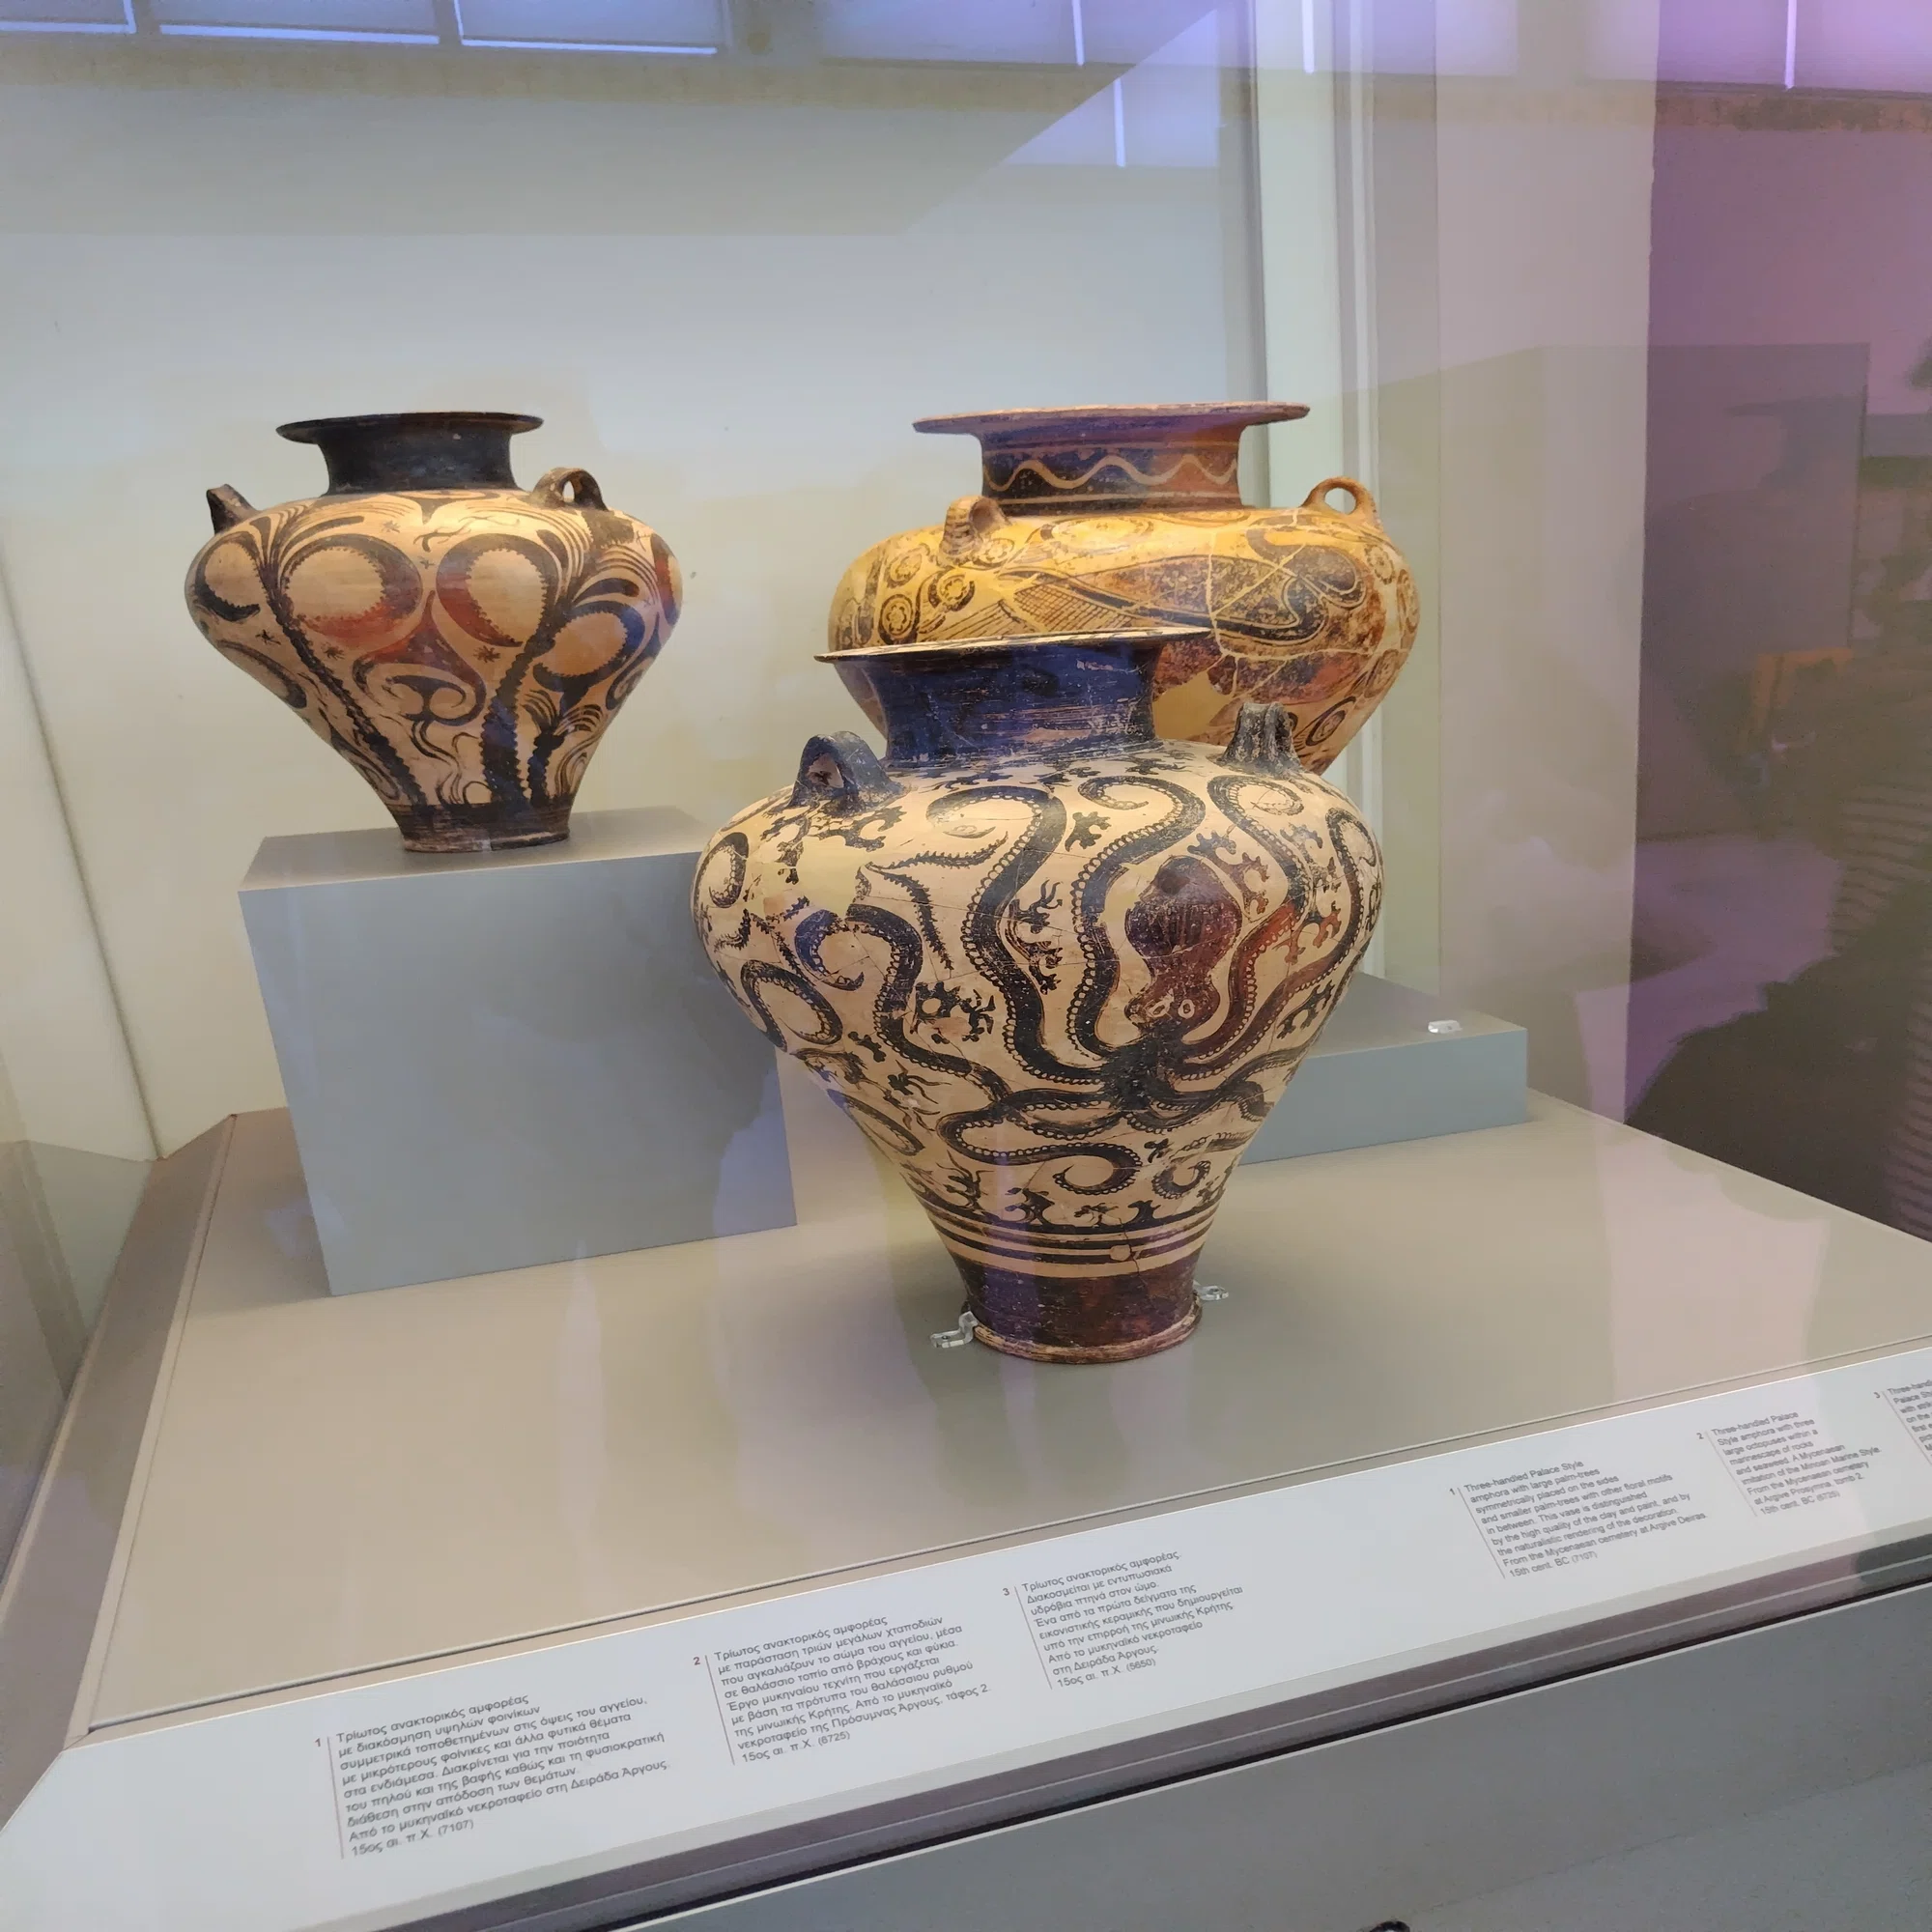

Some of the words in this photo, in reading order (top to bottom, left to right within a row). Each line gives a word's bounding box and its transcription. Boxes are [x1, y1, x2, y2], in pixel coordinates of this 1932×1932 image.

[1463, 1472, 1529, 1492] Three-handled
[1529, 1466, 1560, 1478] Palace
[1561, 1462, 1584, 1471] Style
[1470, 1490, 1511, 1503] amphora
[1511, 1485, 1530, 1493] with
[1529, 1480, 1554, 1490] large
[1476, 1495, 1535, 1515] symmetrically
[1537, 1487, 1567, 1501] placed
[1596, 1476, 1620, 1486] sides
[1481, 1514, 1499, 1524] and
[1500, 1508, 1532, 1520] smaller
[1581, 1492, 1600, 1501] with
[1601, 1487, 1623, 1496] other
[1624, 1480, 1647, 1491] floral
[1647, 1474, 1673, 1486] motifs
[1538, 1514, 1559, 1522] This
[1559, 1508, 1581, 1518] vase
[1592, 1491, 1648, 1510] distinguished
[1502, 1556, 1528, 1567] From
[1528, 1552, 1545, 1561] the
[1545, 1540, 1598, 1557] Mycenaean
[1598, 1530, 1637, 1544] cemetery
[1650, 1520, 1677, 1532] Argive
[1020, 1577, 1065, 1593] Τρίωτος
[1065, 1562, 1128, 1582] ανακτορικός
[1027, 1583, 1091, 1605] Διακοσμείται
[1092, 1580, 1105, 1591] με
[1106, 1563, 1173, 1585] εντυπωσιακά
[1510, 1567, 1530, 1577] 15th
[1554, 1557, 1570, 1566] BC
[1002, 1587, 1010, 1596] 3
[1030, 1600, 1073, 1616] υδρόβια
[1073, 1590, 1107, 1605] πτηνά
[1108, 1586, 1131, 1598] στον
[1059, 1609, 1081, 1622] από
[1082, 1607, 1095, 1616] τα
[1096, 1599, 1132, 1613] πρώτα
[1132, 1589, 1178, 1605] δείγματα
[1179, 1584, 1197, 1594] της
[1038, 1619, 1101, 1640] εικονιστικής
[1101, 1606, 1153, 1625] κεραμικής
[1153, 1602, 1175, 1612] που
[1177, 1586, 1243, 1607] δημιουργείται
[713, 1644, 761, 1662] Τρίωτος
[762, 1629, 831, 1651] ανακτορικός
[832, 1616, 888, 1635] αμφορέας
[717, 1664, 731, 1676] με
[733, 1649, 800, 1669] παράσταση
[801, 1641, 832, 1656] τριών
[835, 1630, 883, 1649] μεγάλων
[885, 1616, 943, 1638] χταποδιών
[720, 1675, 744, 1687] που
[747, 1659, 814, 1681] αγκαλιάζουν
[833, 1647, 866, 1661] σώμα
[867, 1642, 886, 1653] του
[934, 1625, 963, 1639] μέσα
[1042, 1638, 1065, 1652] υπό
[1066, 1635, 1085, 1646] την
[1087, 1624, 1130, 1641] επιρροή
[1130, 1621, 1150, 1631] της
[1048, 1650, 1071, 1663] Από
[1141, 1620, 1203, 1641] νεκροταφείο
[693, 1656, 701, 1665] 2
[724, 1690, 739, 1699] σε
[740, 1677, 795, 1695] θαλάσσιο
[797, 1668, 828, 1682] τοπίο
[830, 1661, 855, 1675] από
[855, 1651, 904, 1671] βράχους
[905, 1647, 923, 1658] και
[761, 1684, 820, 1706] μυκηναίου
[822, 1675, 862, 1690] τεχνίτη
[863, 1669, 886, 1680] που
[888, 1657, 940, 1675] εργάζεται
[1052, 1665, 1073, 1676] στη
[1073, 1654, 1117, 1671] Δειράδα
[1057, 1675, 1084, 1688] 15ος
[335, 1725, 387, 1744] Τρίωτος
[390, 1708, 466, 1731] ανακτορικός
[468, 1694, 529, 1715] αμφορέας
[338, 1747, 353, 1758] με
[356, 1729, 432, 1752] διακόσμηση
[435, 1718, 484, 1735] υψηλών
[487, 1706, 540, 1725] φοινίκων
[733, 1726, 754, 1737] της
[855, 1695, 879, 1709] Από
[881, 1693, 895, 1702] το
[737, 1727, 808, 1749] νεκροταφείο
[810, 1722, 830, 1733] της
[831, 1706, 897, 1728] Πρόσυμνας
[945, 1687, 980, 1701] τάφος
[314, 1737, 321, 1747] 1
[339, 1746, 412, 1771] συμμετρικά
[414, 1726, 510, 1753] τοποθετημένων
[513, 1719, 538, 1732] στις
[539, 1712, 574, 1726] όψεις
[575, 1707, 596, 1718] του
[342, 1774, 357, 1786] με
[360, 1755, 438, 1782] μικρότερους
[440, 1744, 491, 1764] φοίνικες
[494, 1739, 512, 1750] και
[514, 1732, 544, 1746] άλλα
[547, 1721, 586, 1740] φυτικά
[588, 1714, 632, 1729] θέματα
[741, 1749, 771, 1762] 15ος
[343, 1786, 367, 1799] στα
[441, 1754, 509, 1776] Διακρίνεται
[512, 1749, 530, 1762] για
[533, 1744, 554, 1755] την
[556, 1731, 610, 1749] ποιότητα
[349, 1826, 378, 1842] Από
[381, 1824, 395, 1834] το
[467, 1788, 543, 1813] νεκροταφείο
[545, 1783, 568, 1795] στη
[570, 1771, 619, 1789] Δειράδα
[351, 1841, 384, 1856] 15ος
